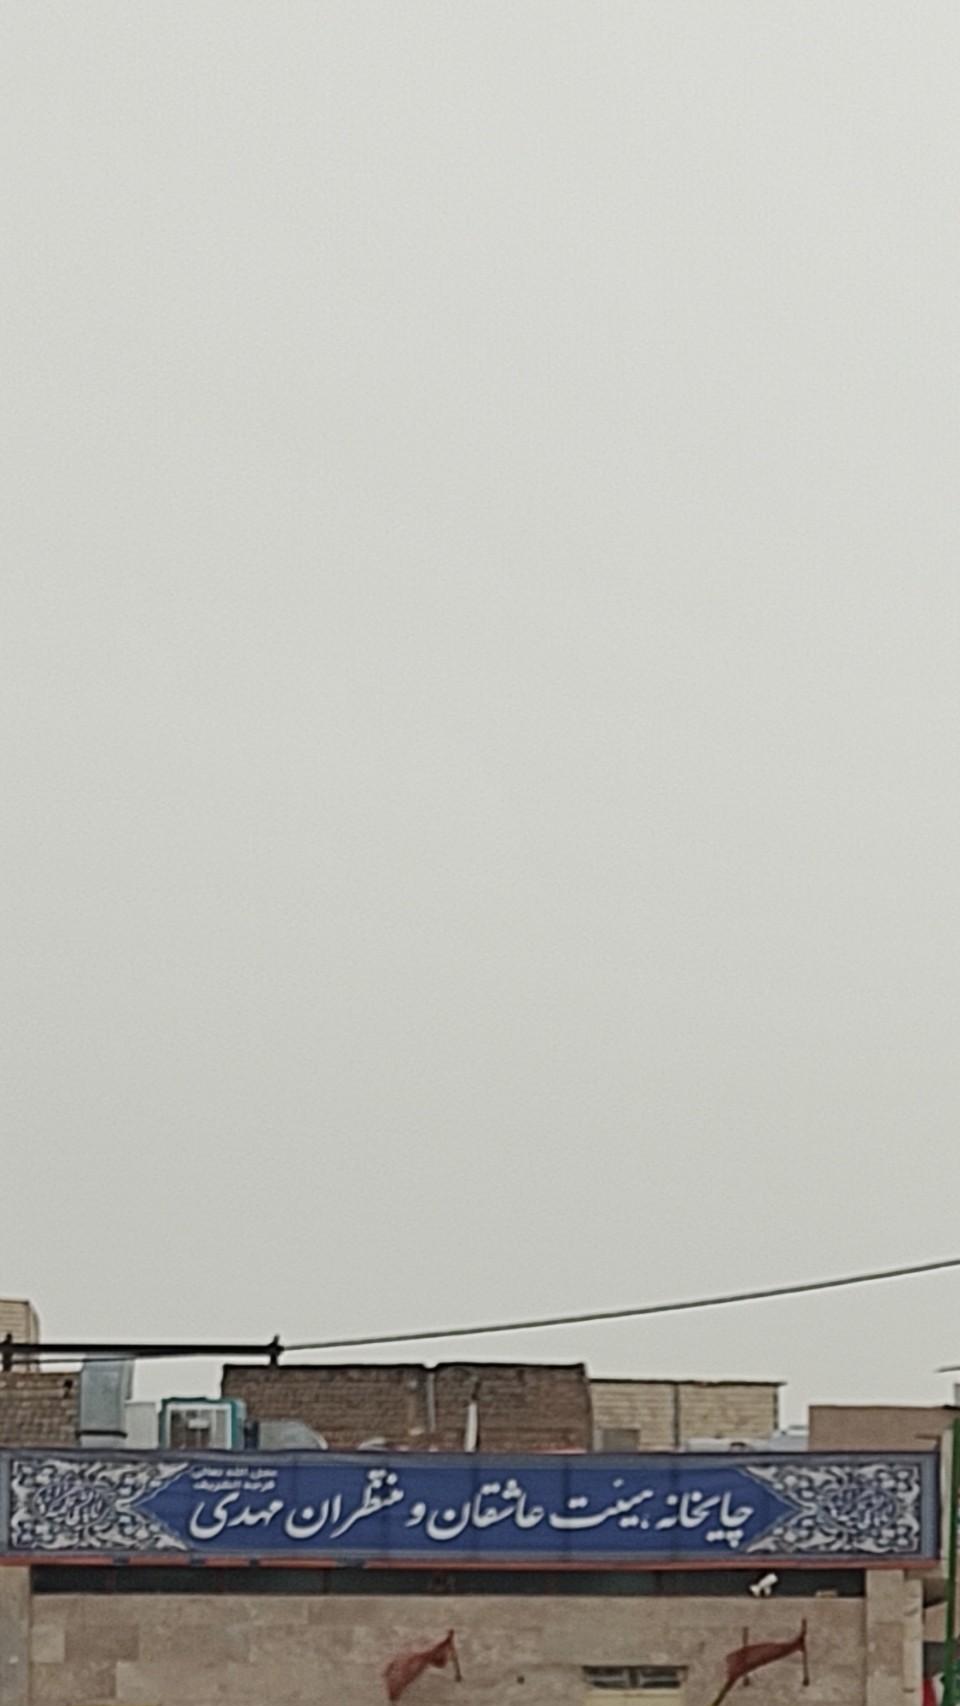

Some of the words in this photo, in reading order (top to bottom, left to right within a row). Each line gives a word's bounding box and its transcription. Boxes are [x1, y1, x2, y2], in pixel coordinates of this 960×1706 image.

[189, 1491, 284, 1540] مهدی
[406, 1501, 426, 1529] و
[426, 1479, 544, 1540] عاشقان
